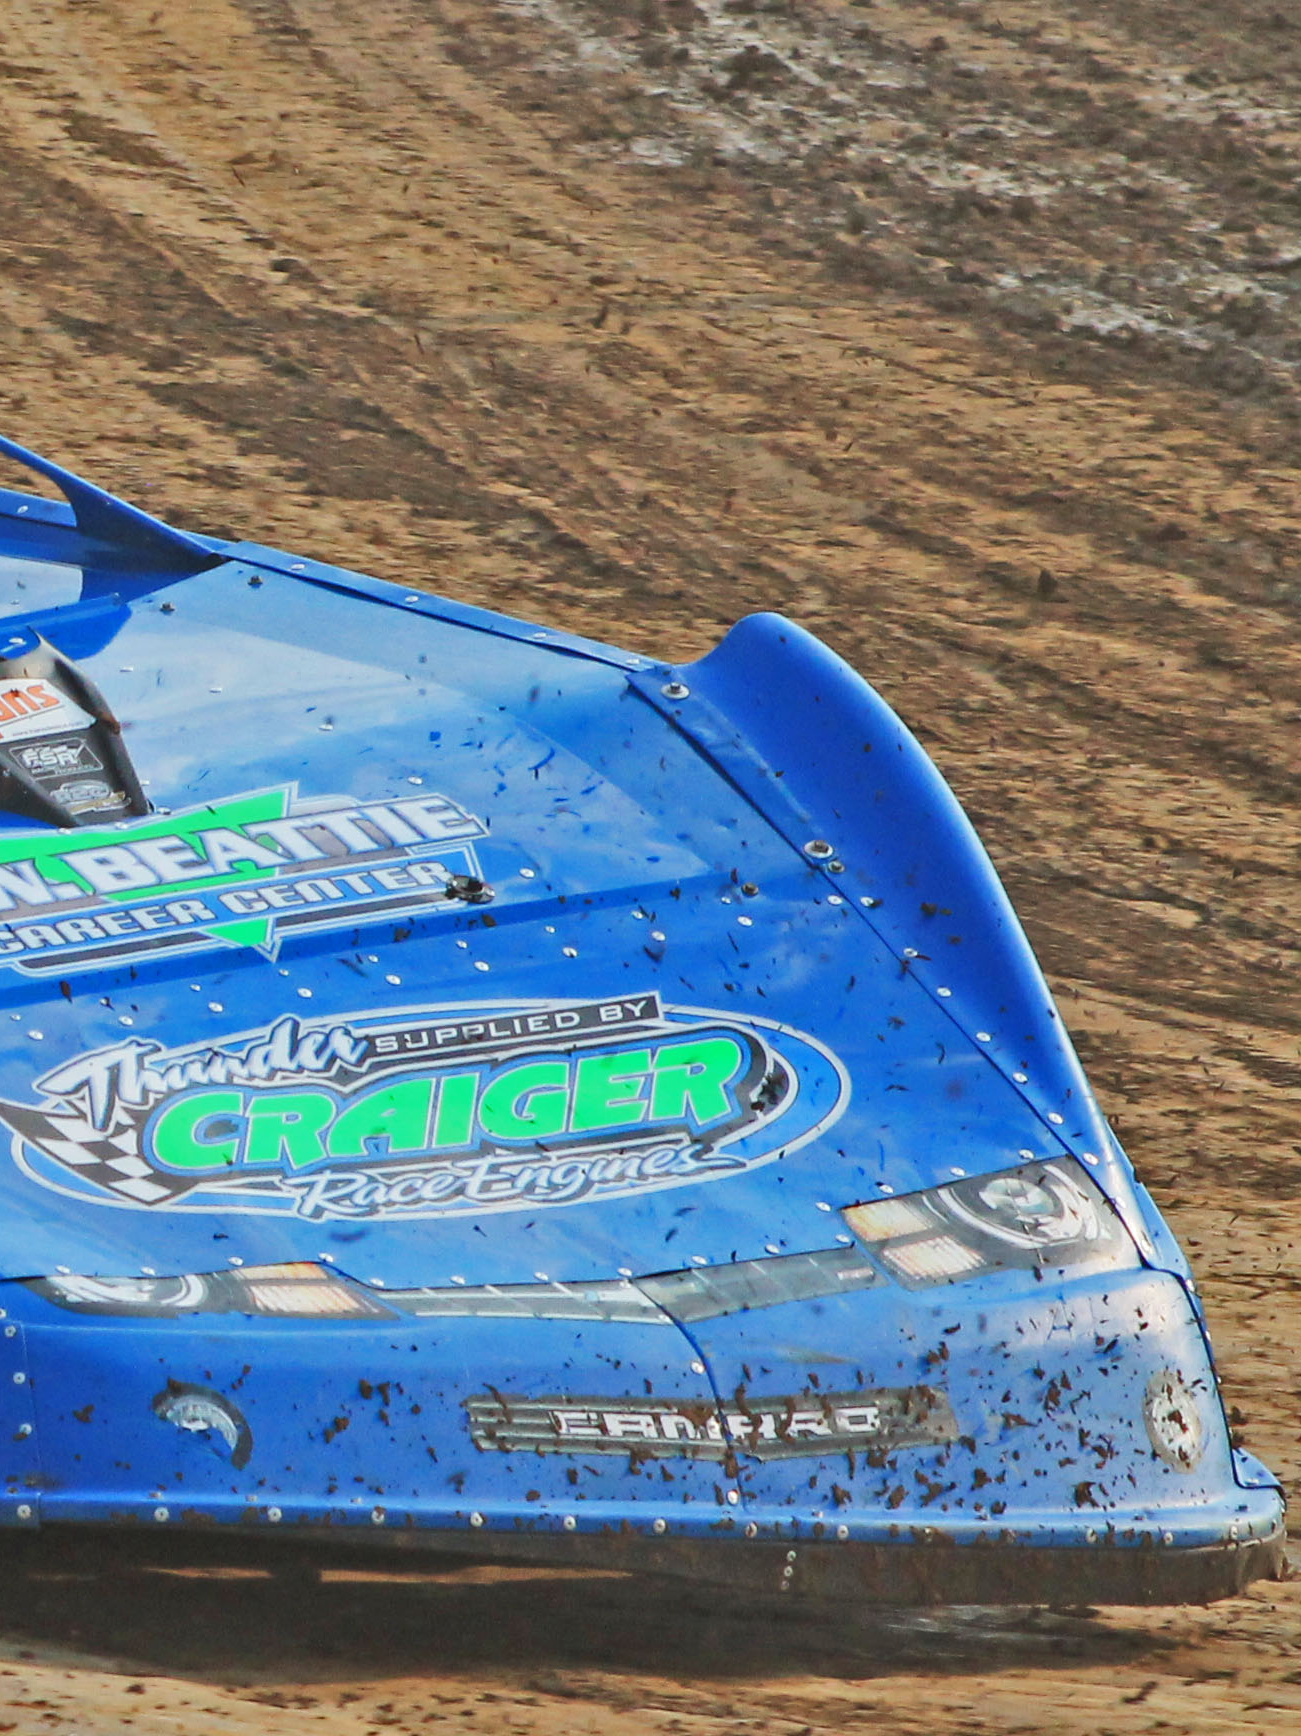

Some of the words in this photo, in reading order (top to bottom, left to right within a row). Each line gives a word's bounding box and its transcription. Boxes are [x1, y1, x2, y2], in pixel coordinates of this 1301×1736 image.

[81, 800, 481, 894] BEATTIE
[219, 861, 453, 915] CENTER
[33, 1017, 369, 1129] Thunder
[374, 1012, 581, 1054] SUPPLIED
[599, 1001, 650, 1022] BY
[152, 1037, 742, 1170] CRAIGER
